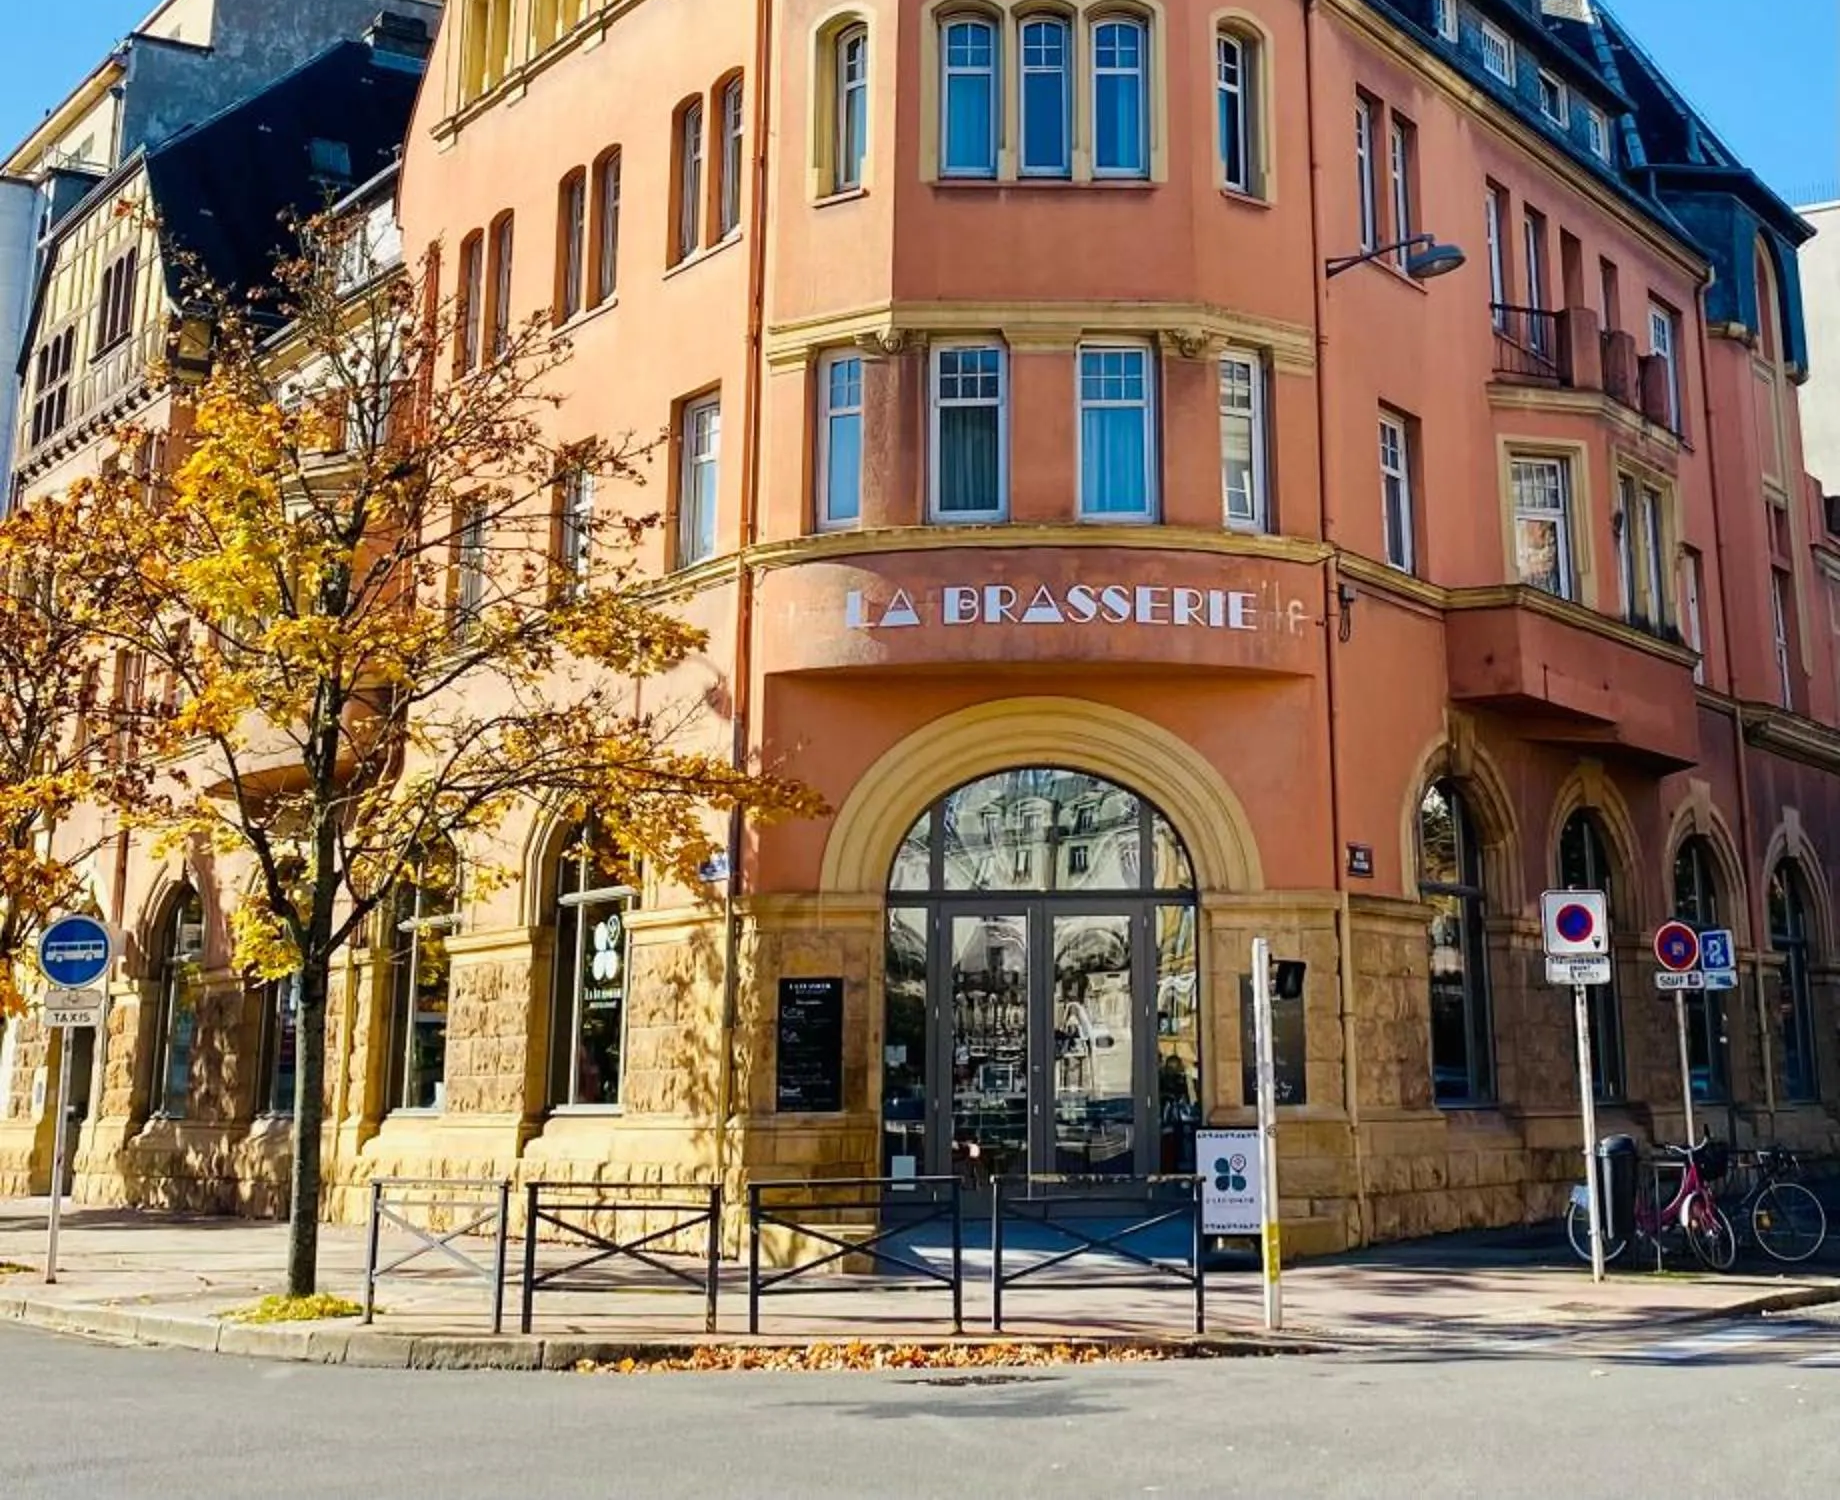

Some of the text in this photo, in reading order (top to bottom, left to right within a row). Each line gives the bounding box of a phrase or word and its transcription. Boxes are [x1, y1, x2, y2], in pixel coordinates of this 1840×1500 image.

[846, 587, 921, 629] LA
[943, 583, 1258, 631] BRASSERIE
[53, 1012, 92, 1023] TAXIS
